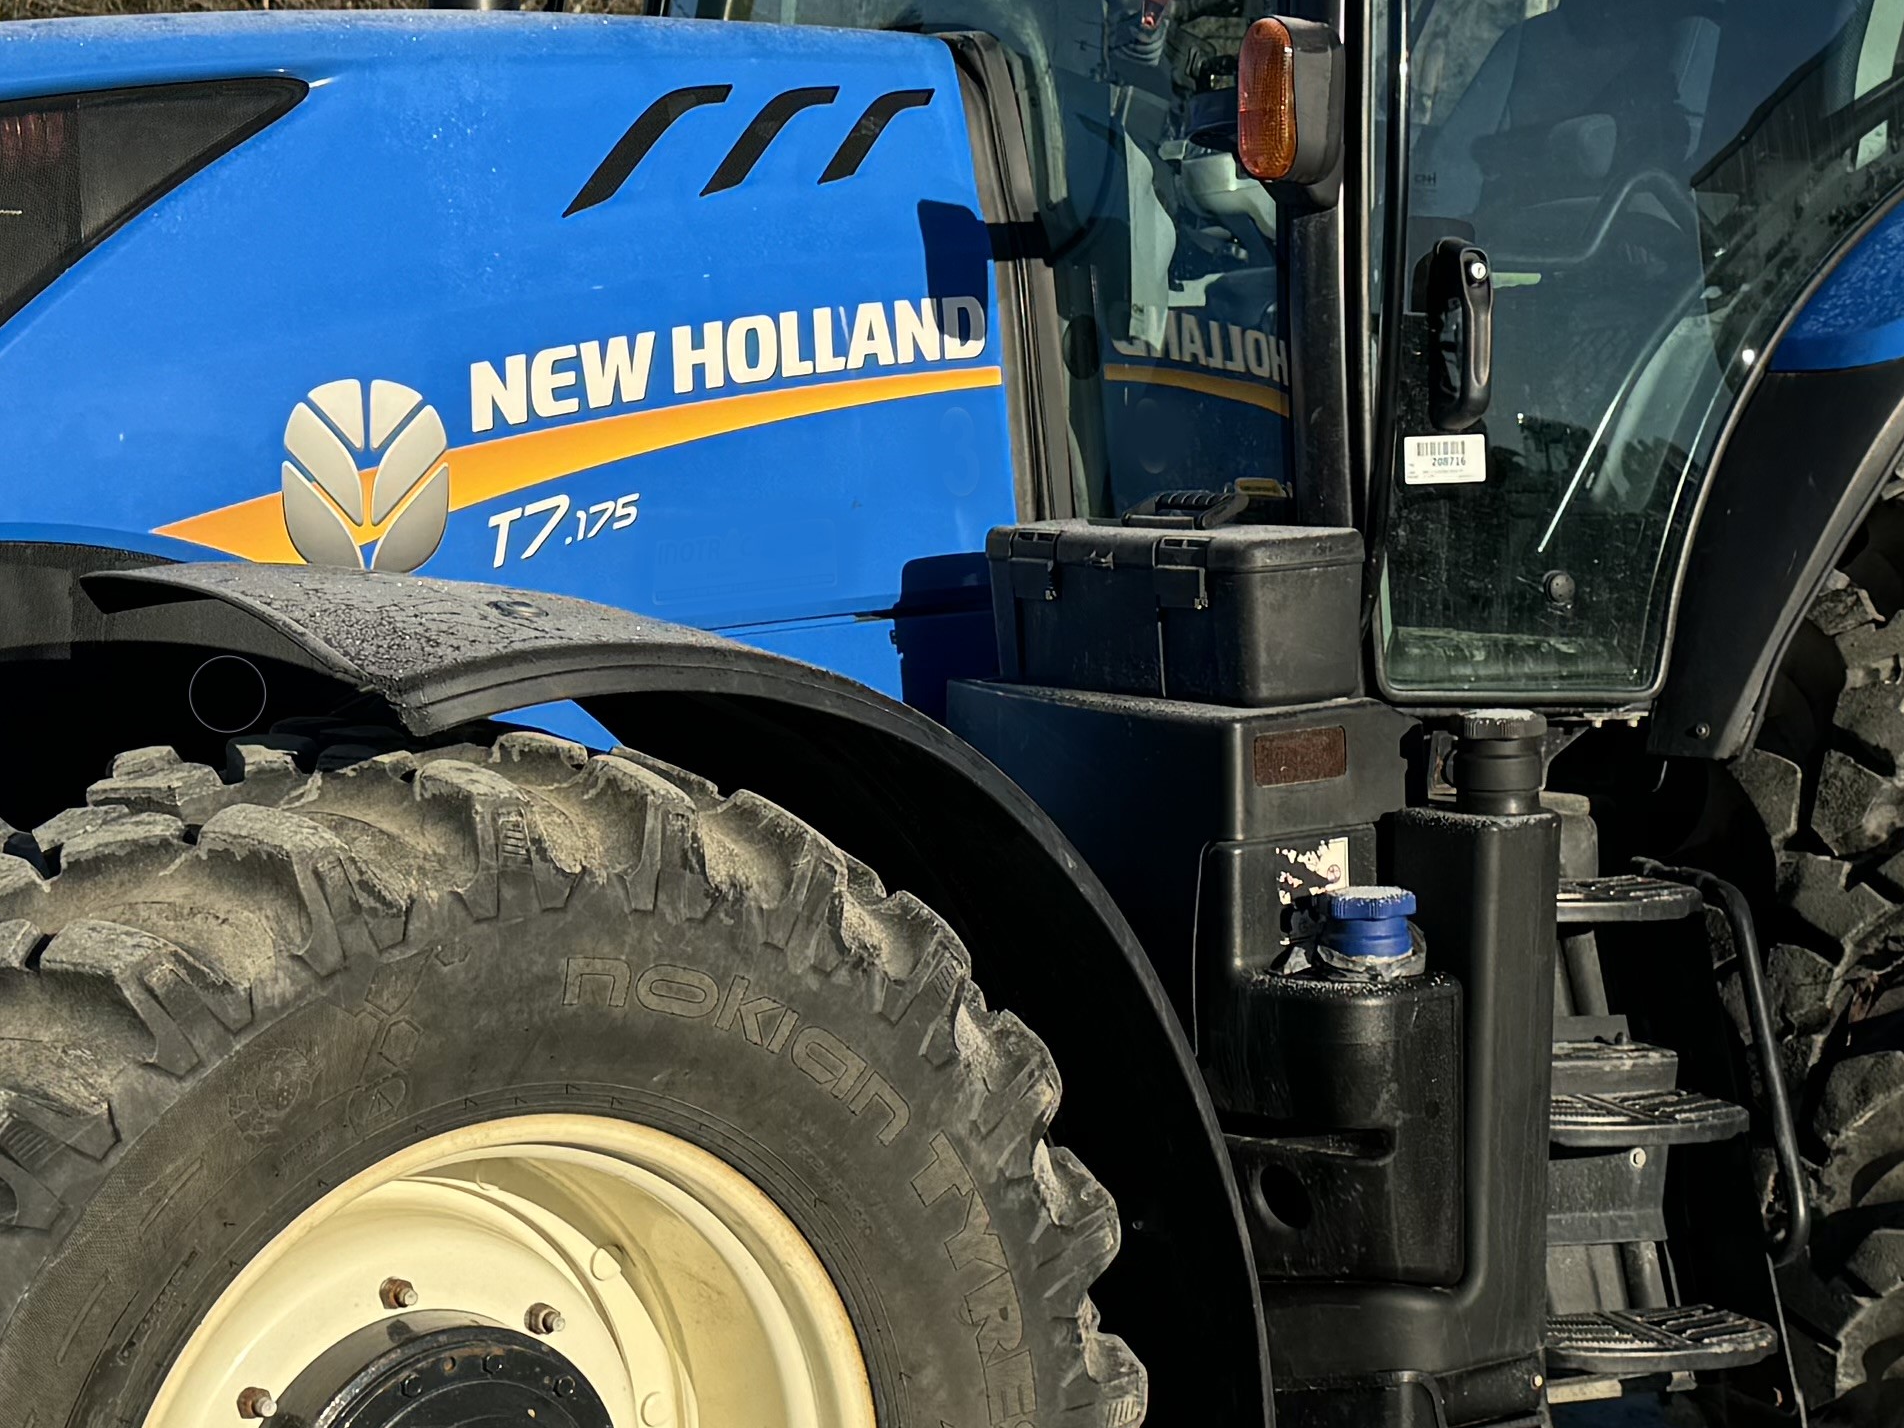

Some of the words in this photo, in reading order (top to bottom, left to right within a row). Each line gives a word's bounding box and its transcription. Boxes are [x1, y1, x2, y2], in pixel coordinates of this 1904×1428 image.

[470, 330, 656, 433] NEW
[671, 296, 986, 395] HOLLAND
[488, 492, 640, 569] T7.175
